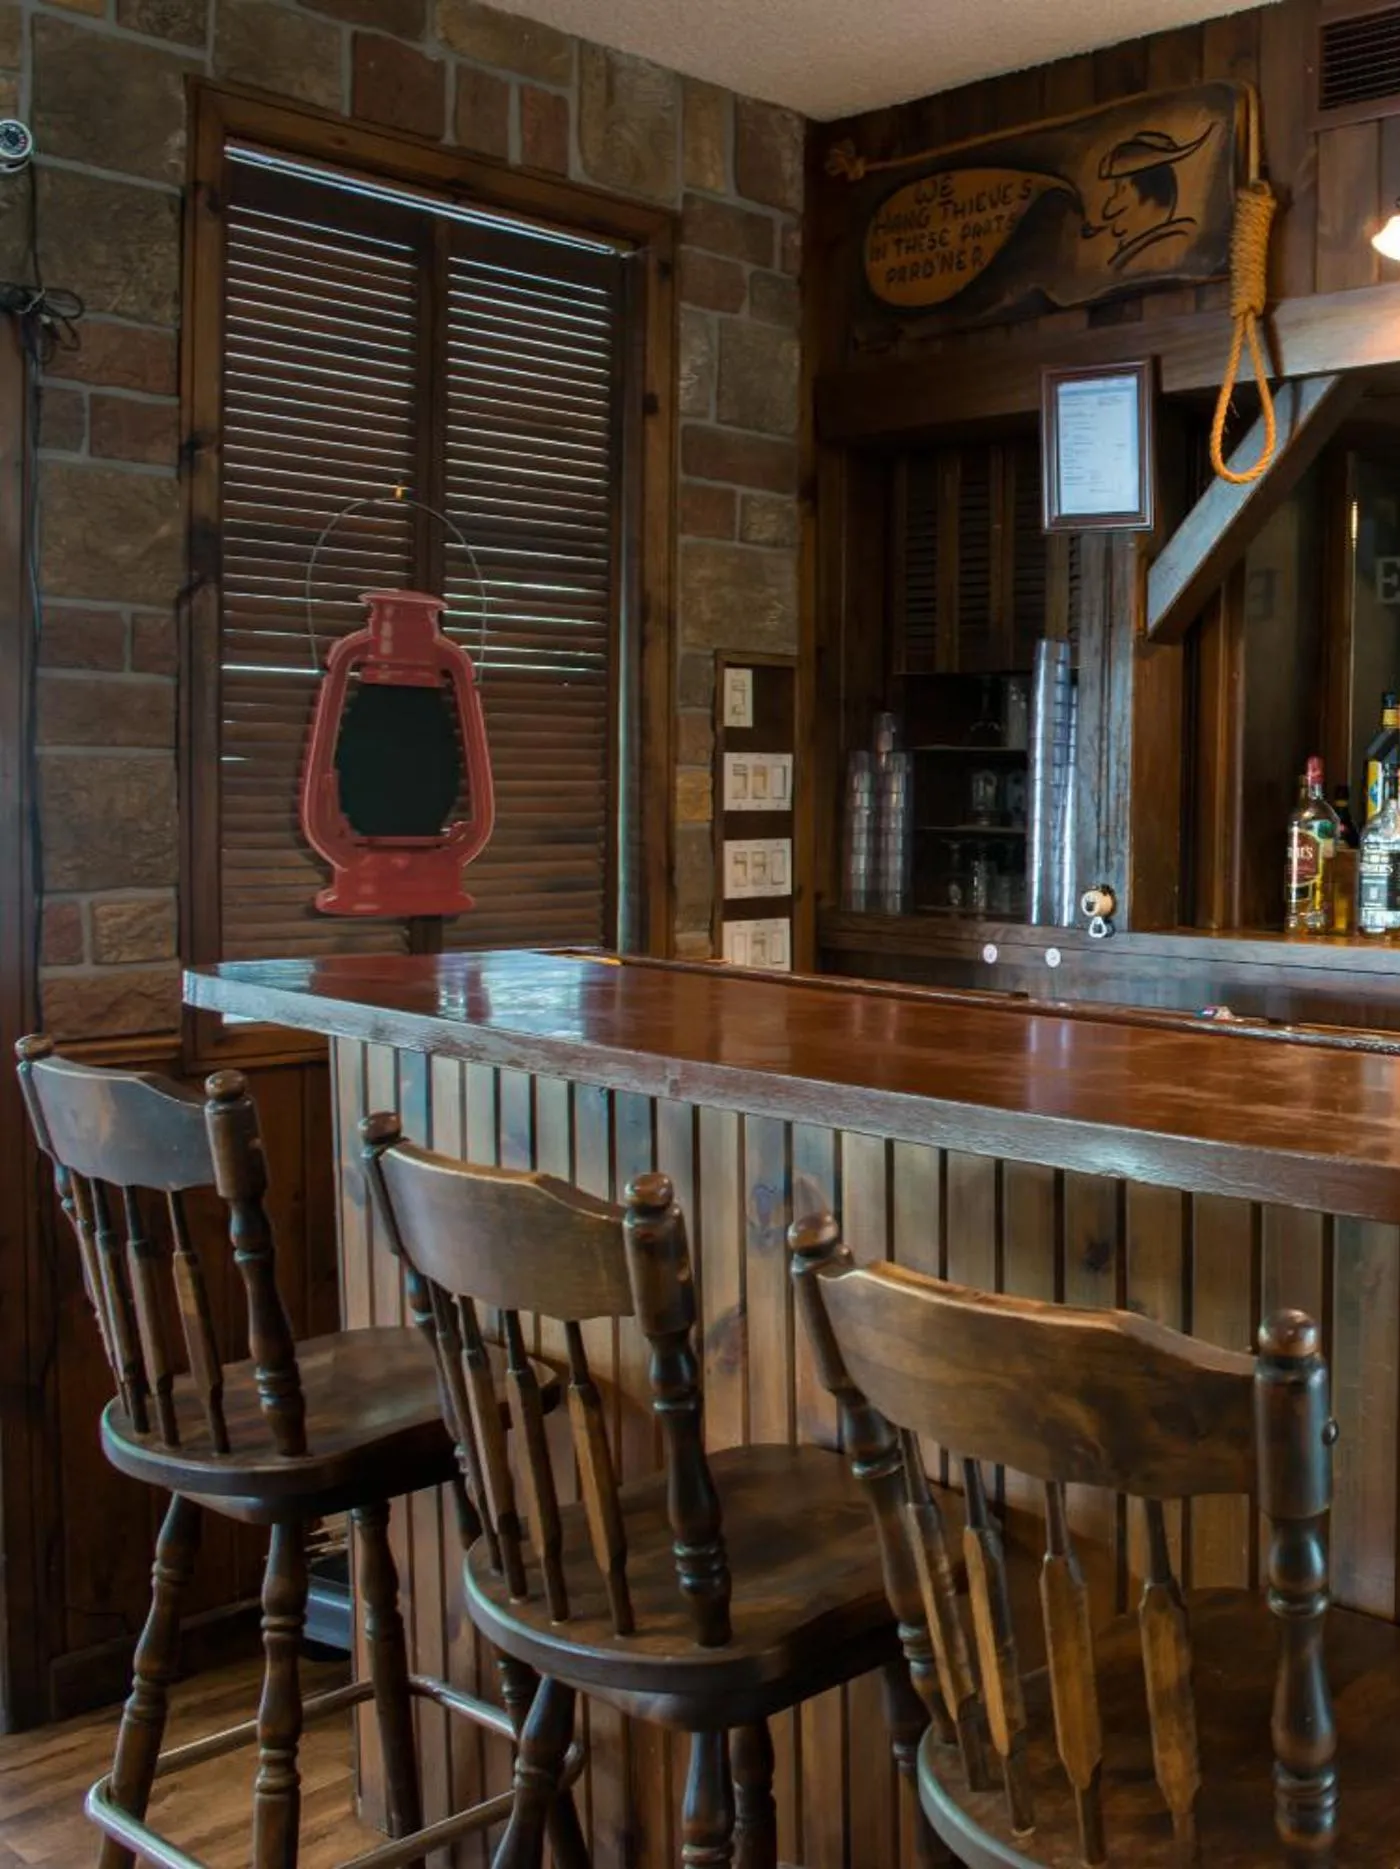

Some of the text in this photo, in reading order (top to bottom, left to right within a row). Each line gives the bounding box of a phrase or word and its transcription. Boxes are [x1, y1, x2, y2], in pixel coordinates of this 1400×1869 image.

[874, 178, 1033, 235] HANG THIEVES
[914, 175, 955, 206] WE
[870, 212, 1020, 262] IN THESE PARTS
